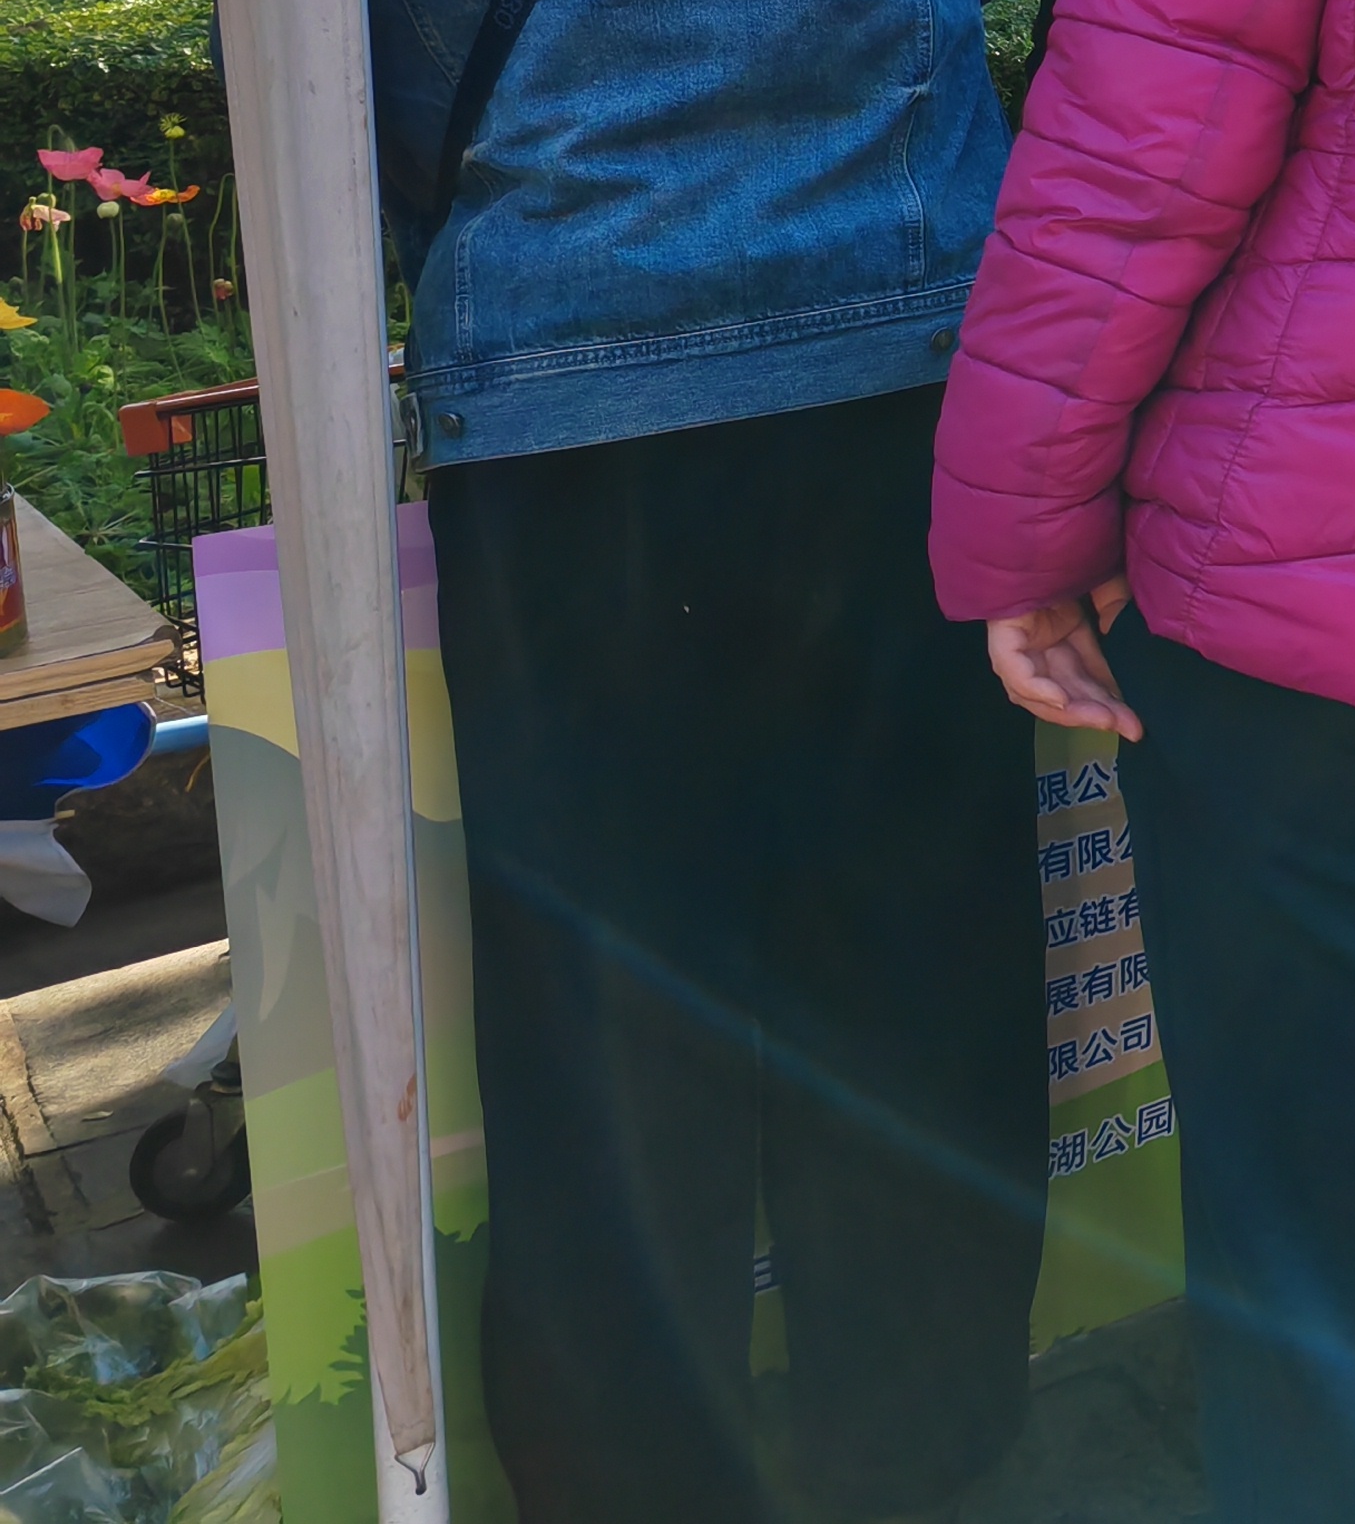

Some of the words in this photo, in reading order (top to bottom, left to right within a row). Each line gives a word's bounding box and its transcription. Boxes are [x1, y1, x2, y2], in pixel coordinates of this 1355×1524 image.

[1037, 758, 1118, 813] 限公
[1049, 1014, 1153, 1078] 限公司
[1050, 1100, 1174, 1174] 湖公园
